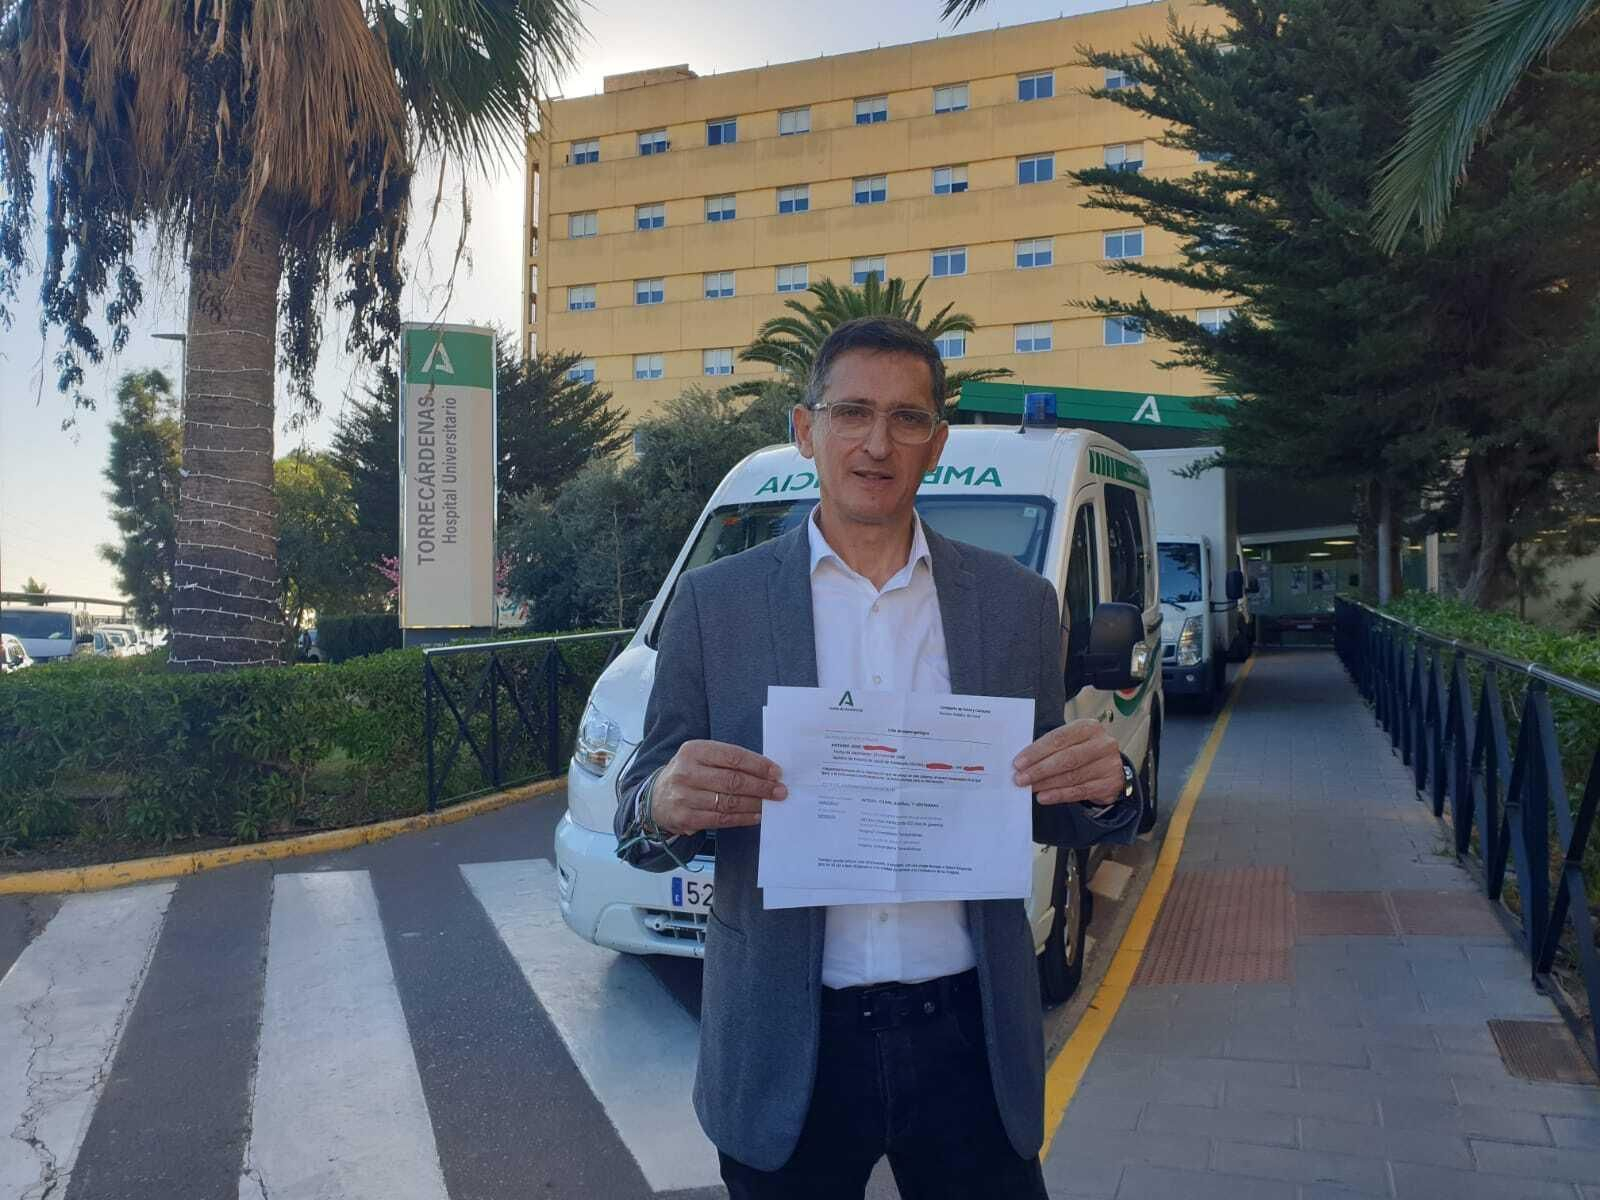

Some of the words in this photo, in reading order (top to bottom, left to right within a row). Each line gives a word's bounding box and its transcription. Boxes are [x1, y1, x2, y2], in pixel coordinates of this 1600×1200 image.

[414, 396, 436, 565] TORRECÁRDENAS
[442, 397, 457, 483] Universitario
[442, 489, 459, 543] Hospital
